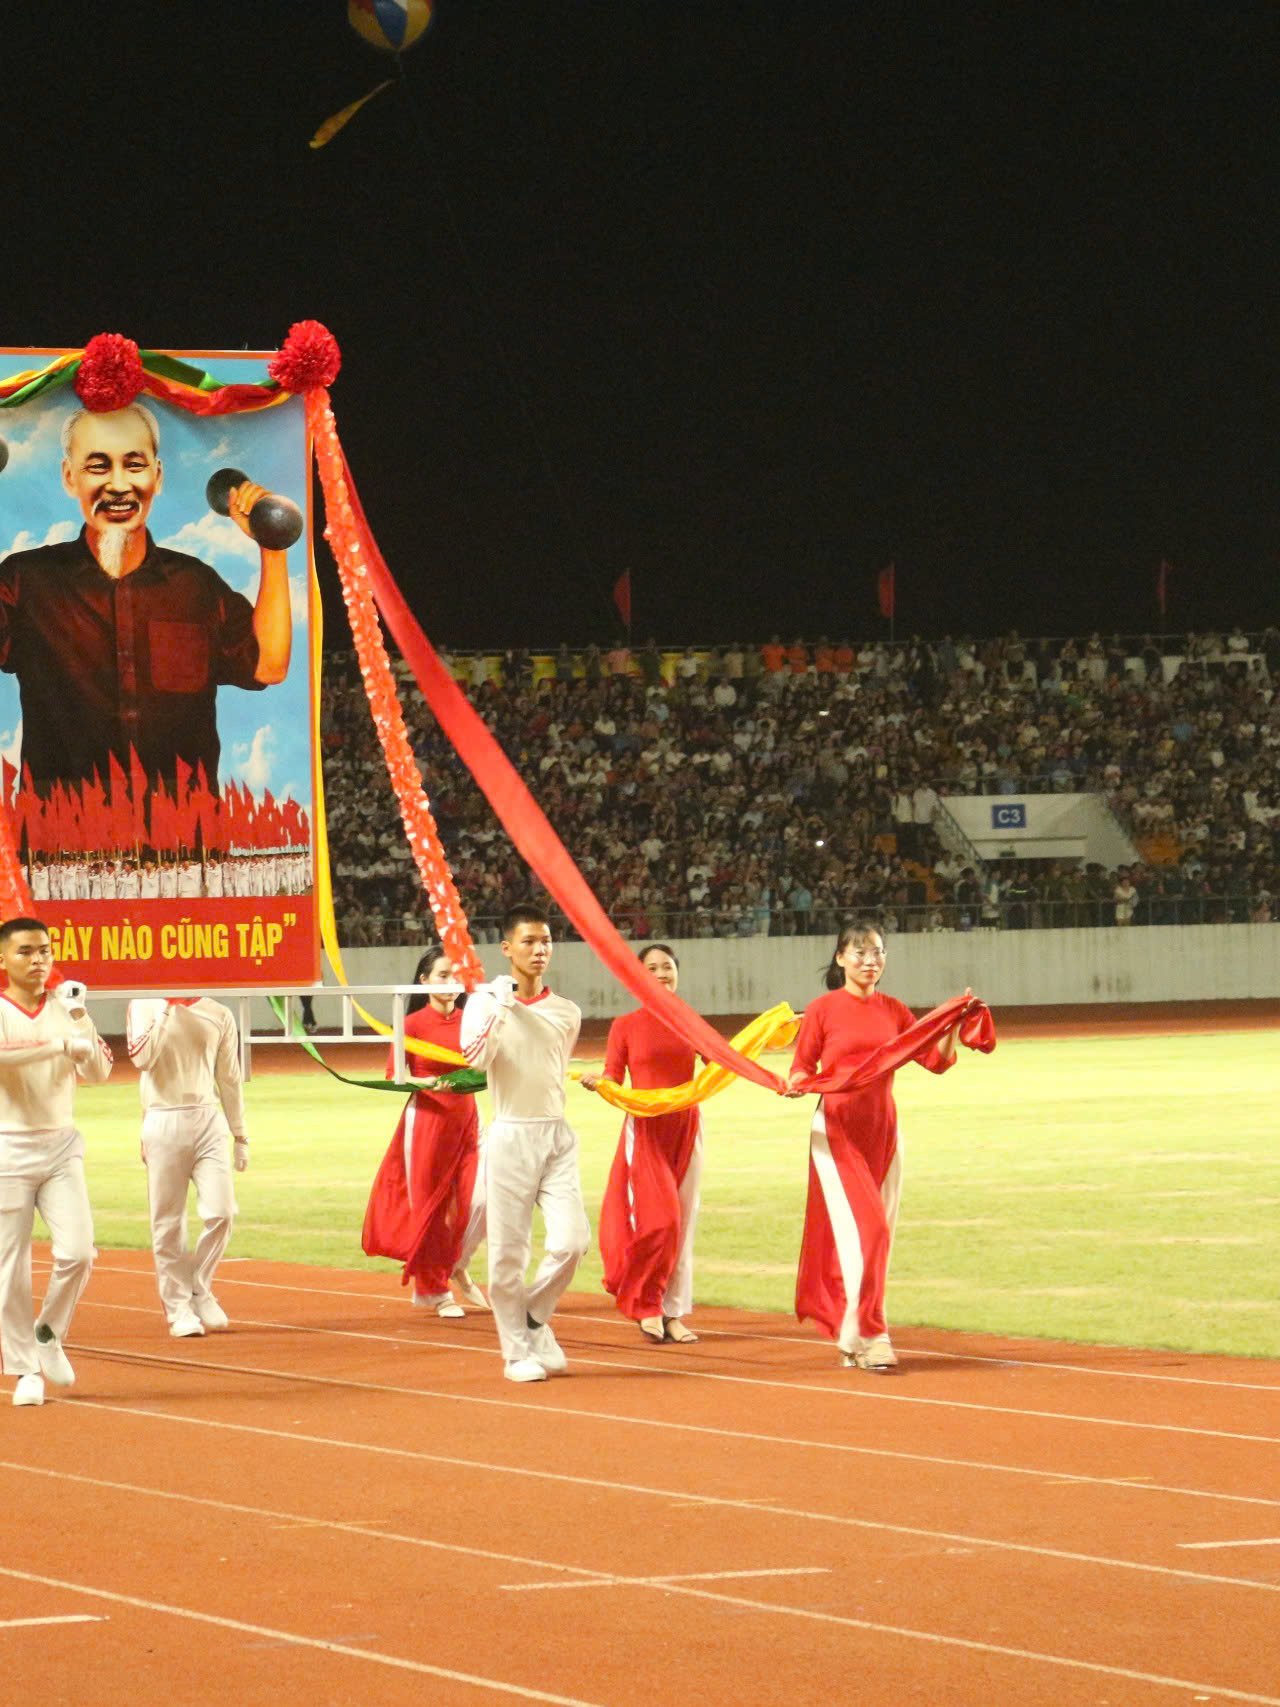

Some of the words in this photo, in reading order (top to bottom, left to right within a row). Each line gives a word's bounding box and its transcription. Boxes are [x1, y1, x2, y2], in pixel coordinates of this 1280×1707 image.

[998, 809, 1021, 824] C3
[48, 918, 94, 962] GÀY
[101, 917, 153, 961] NÀO
[161, 917, 230, 960] CŨNG
